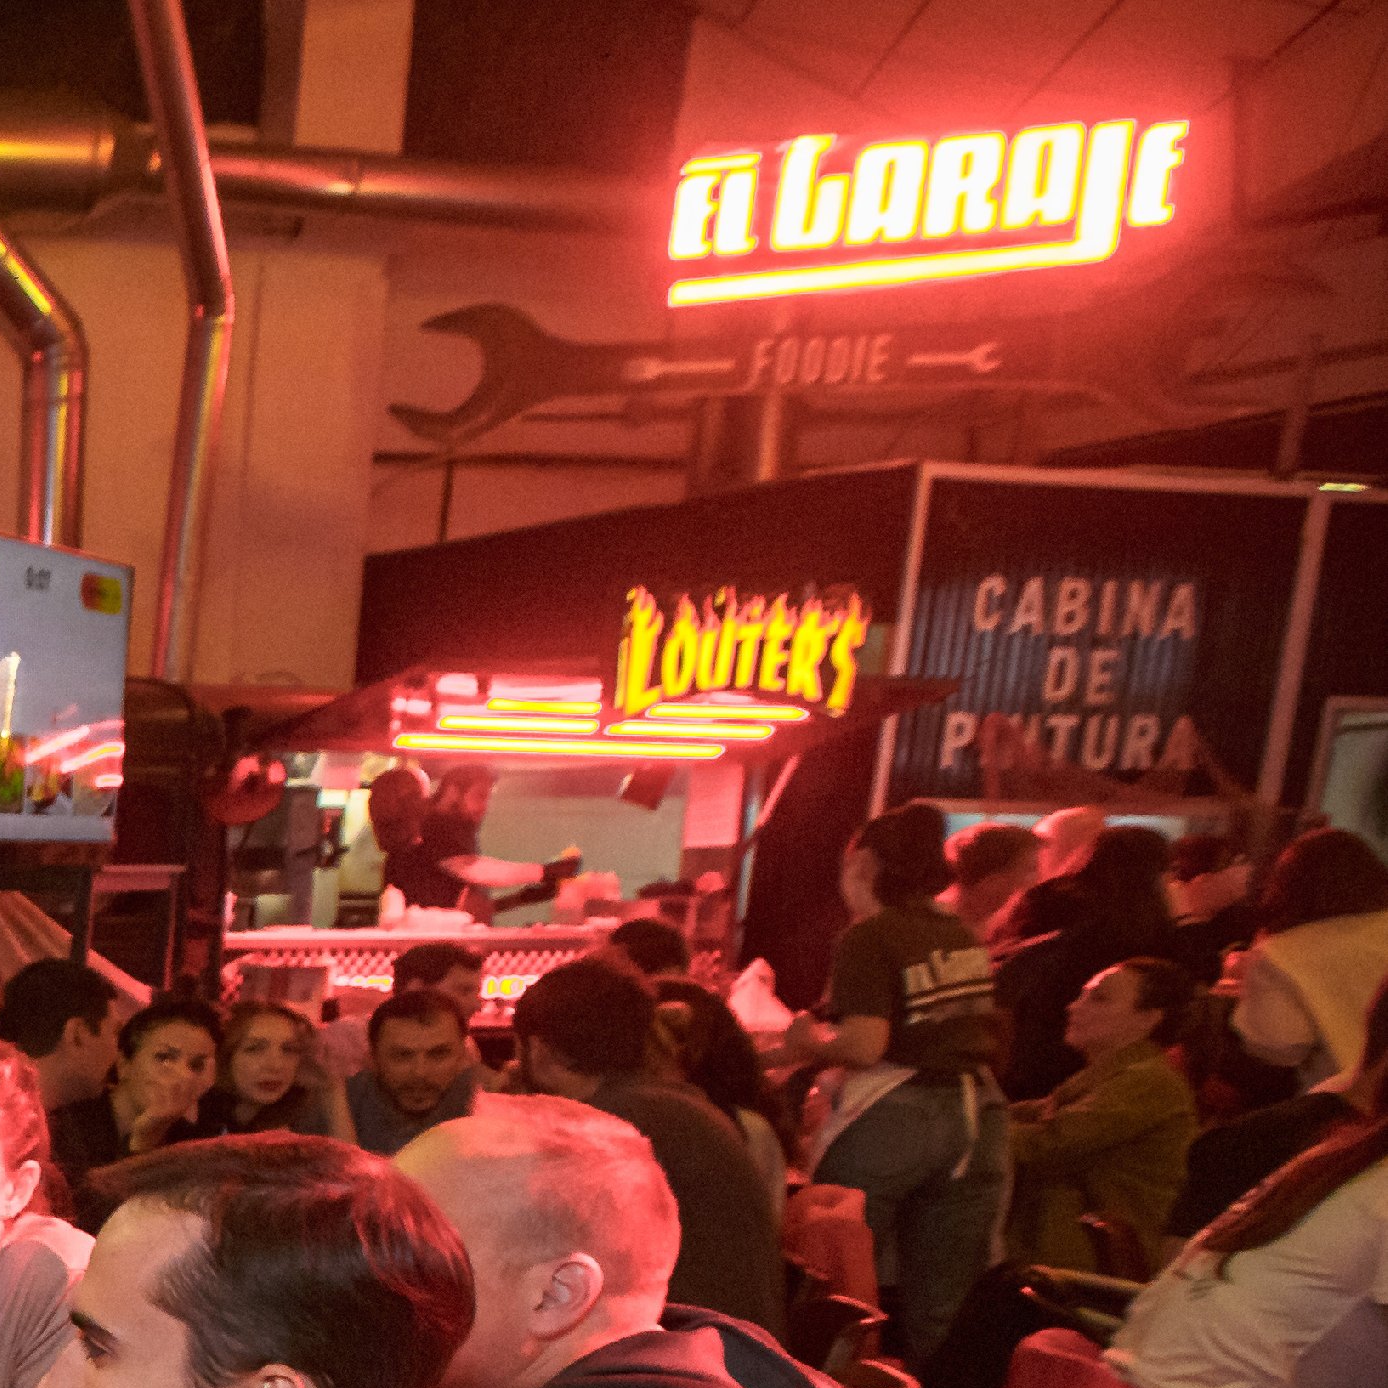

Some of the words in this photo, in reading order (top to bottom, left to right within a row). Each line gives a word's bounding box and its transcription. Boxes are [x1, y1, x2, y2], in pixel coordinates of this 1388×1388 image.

[668, 153, 762, 261] EL
[770, 118, 1190, 264] GARAJE
[747, 333, 894, 392] FOODIE
[974, 571, 1196, 641] CABINA
[1042, 645, 1121, 704] DE
[938, 711, 1197, 772] PTURA
